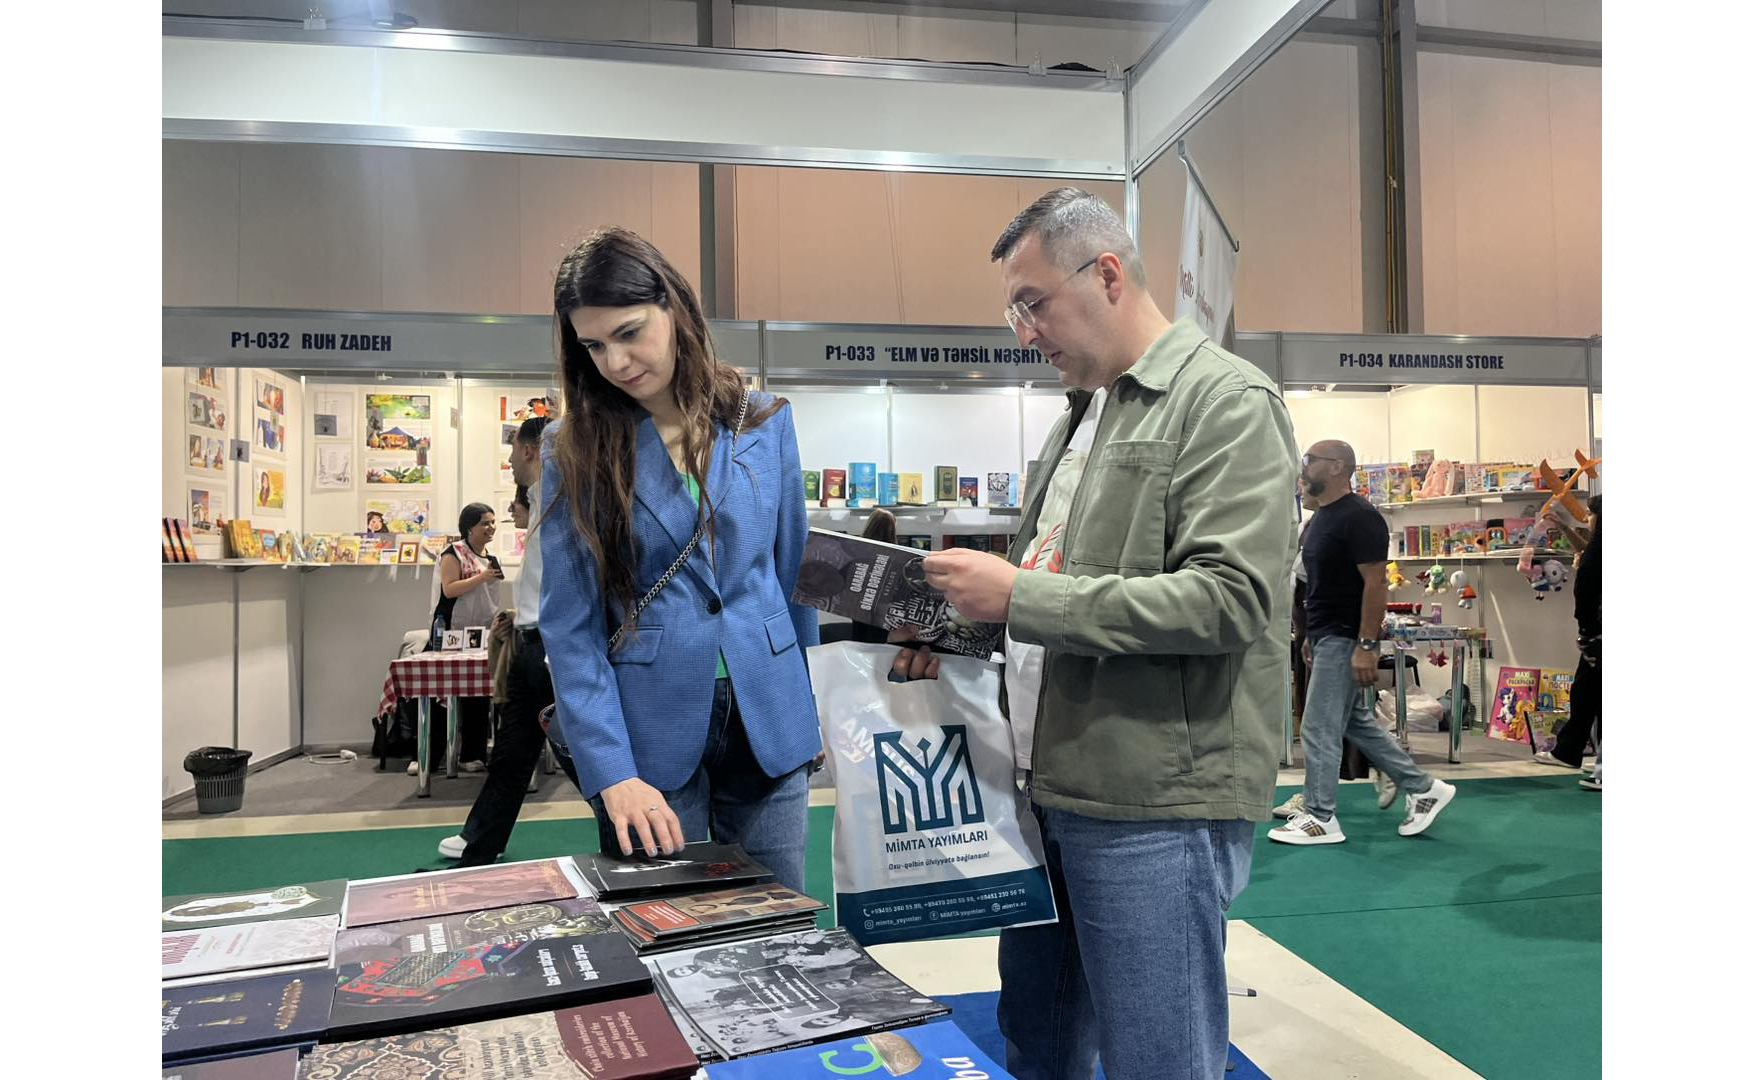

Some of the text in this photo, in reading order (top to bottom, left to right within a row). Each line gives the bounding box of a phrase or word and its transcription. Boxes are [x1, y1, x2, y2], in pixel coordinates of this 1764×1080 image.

[231, 331, 392, 351] P1-032 RUH ZADEH
[825, 345, 875, 361] P1-033
[921, 347, 940, 363] VƏ
[942, 345, 990, 363] TƏHSİL
[1339, 353, 1505, 369] P1-034 KARANDASH STORE
[850, 562, 869, 592] QARABAĞ
[885, 830, 989, 853] MİMTA YAYIMLARI
